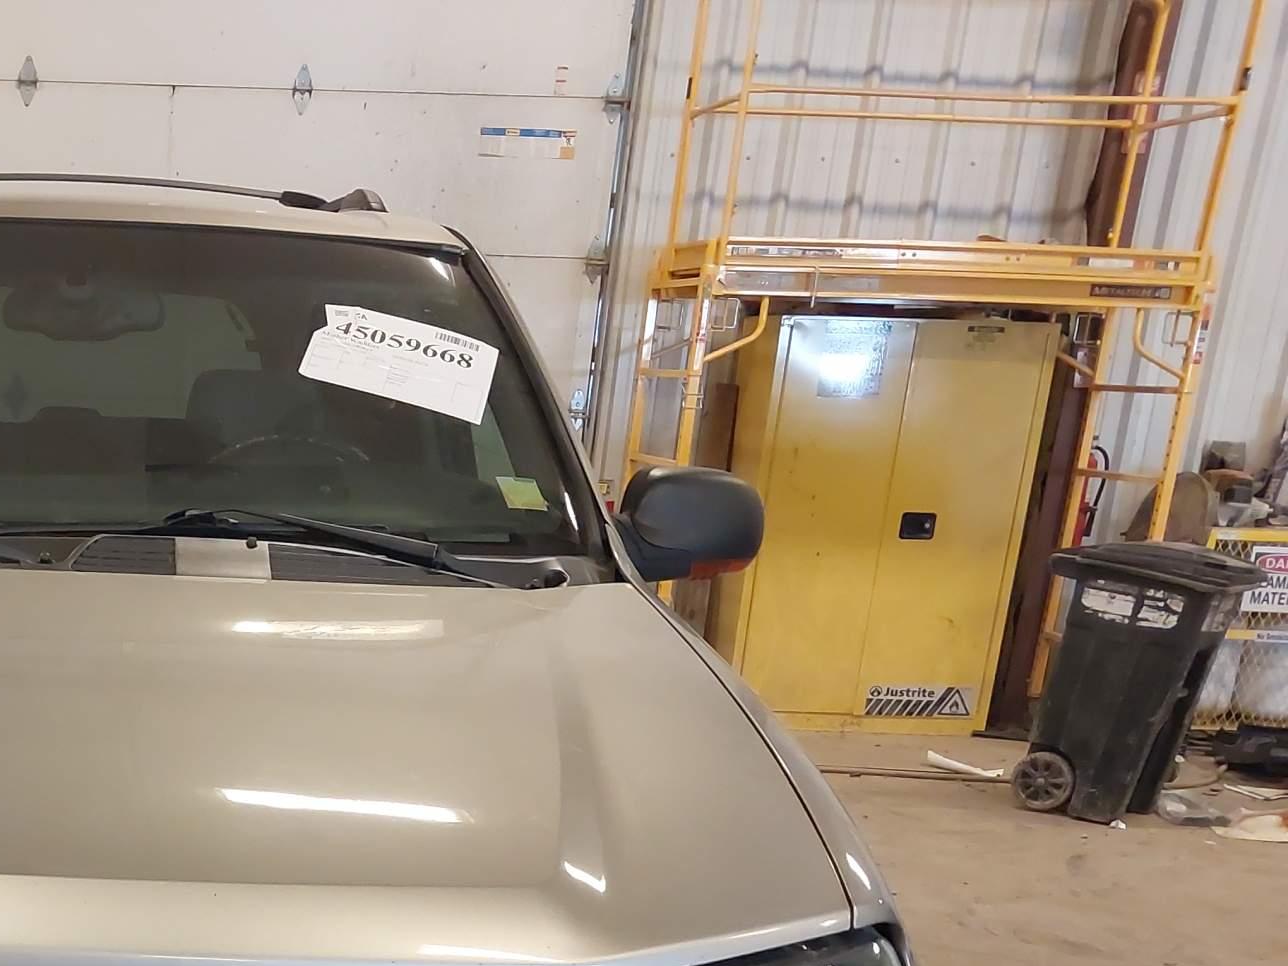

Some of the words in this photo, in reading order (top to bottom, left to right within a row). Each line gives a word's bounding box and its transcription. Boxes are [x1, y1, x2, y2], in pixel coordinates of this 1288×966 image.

[336, 321, 474, 369] 45059668
[1268, 575, 1288, 589] AM
[884, 687, 935, 698] Justrite
